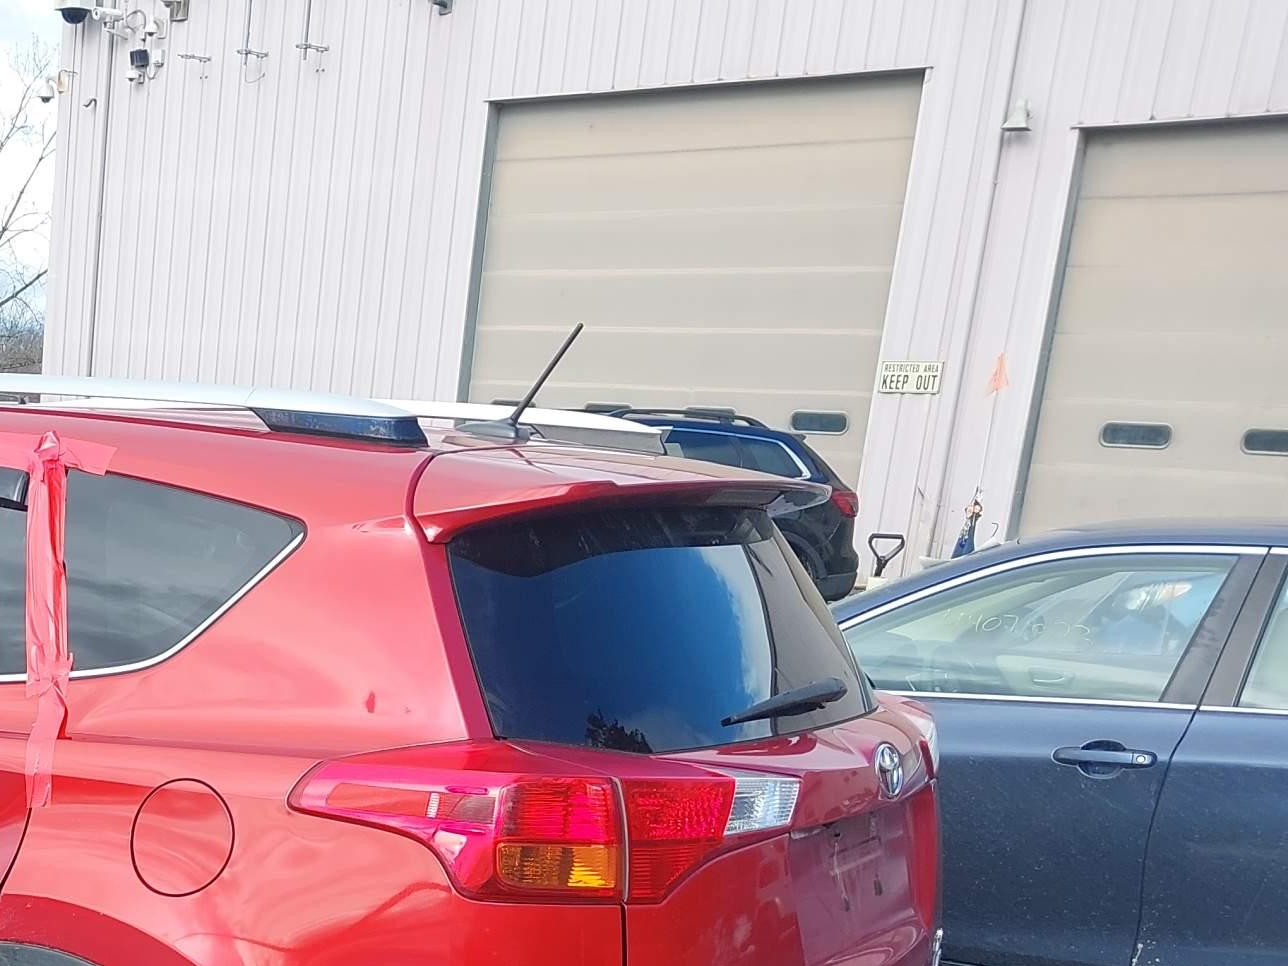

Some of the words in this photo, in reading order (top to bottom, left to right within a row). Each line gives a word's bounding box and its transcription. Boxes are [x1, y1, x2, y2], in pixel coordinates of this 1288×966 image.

[884, 363, 921, 373] RESTRICTED
[923, 364, 939, 373] AREA
[881, 374, 909, 390] KEEP
[915, 374, 938, 391] OUT
